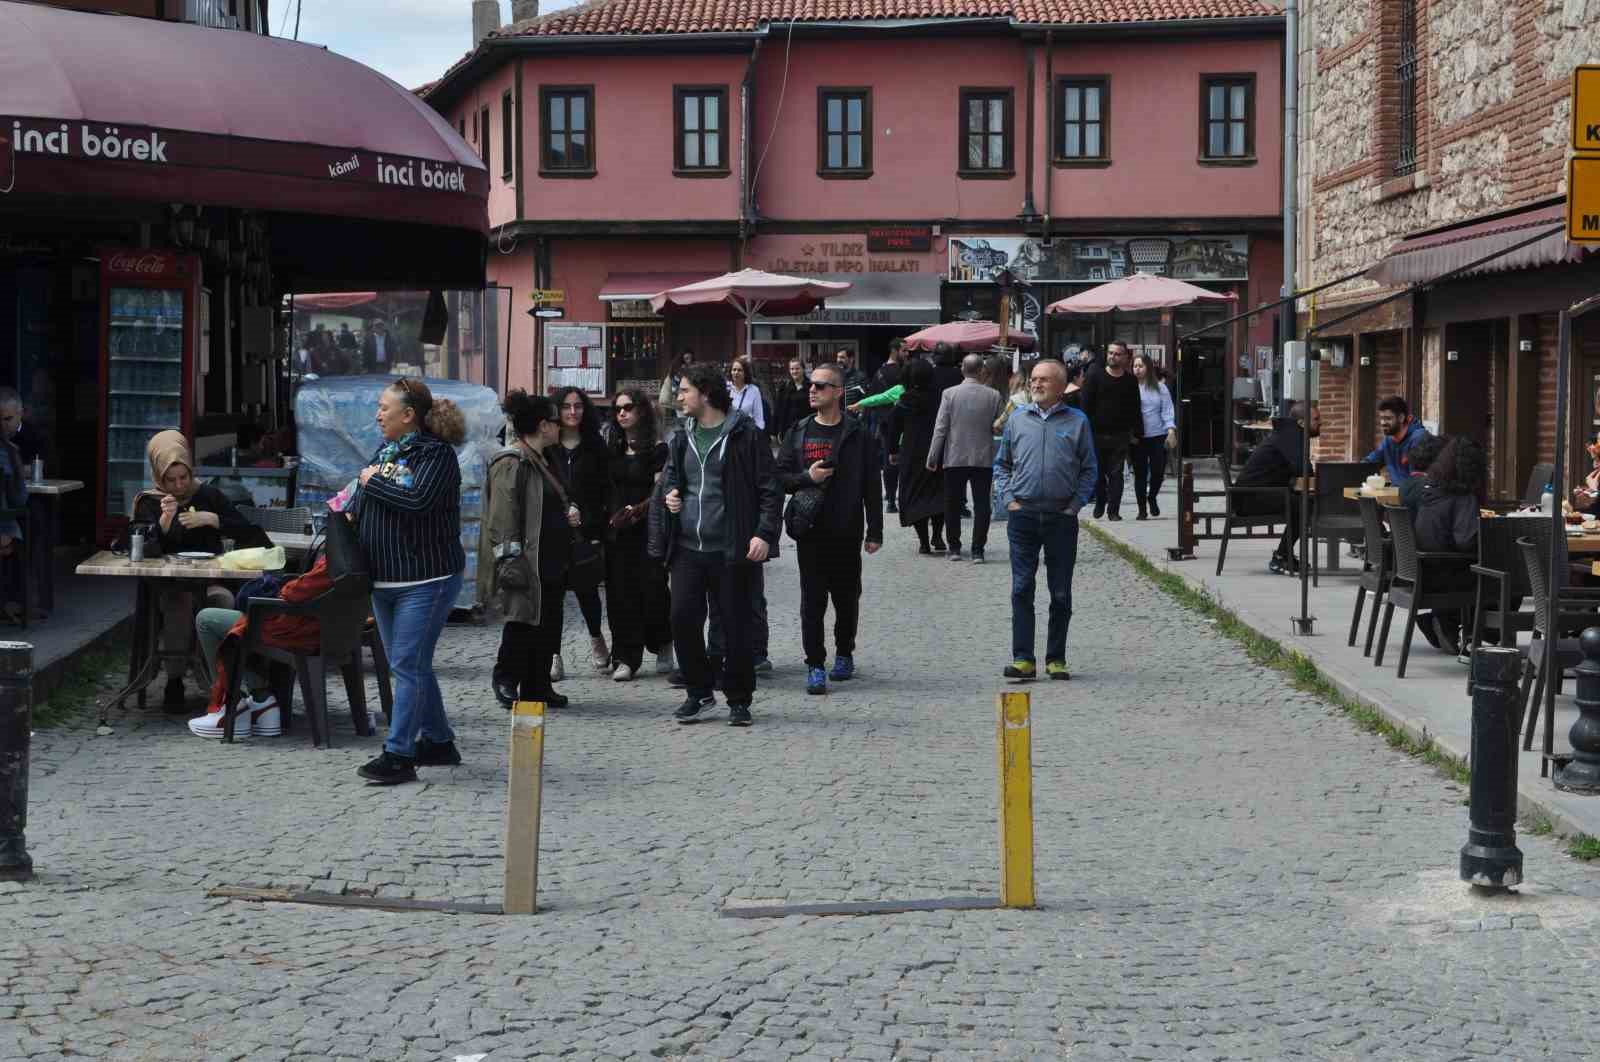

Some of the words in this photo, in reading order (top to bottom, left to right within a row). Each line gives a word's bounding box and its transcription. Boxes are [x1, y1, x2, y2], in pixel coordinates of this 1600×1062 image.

[13, 120, 69, 155] inci
[81, 125, 168, 162] börek
[377, 156, 415, 186] inci
[421, 161, 466, 192] börek
